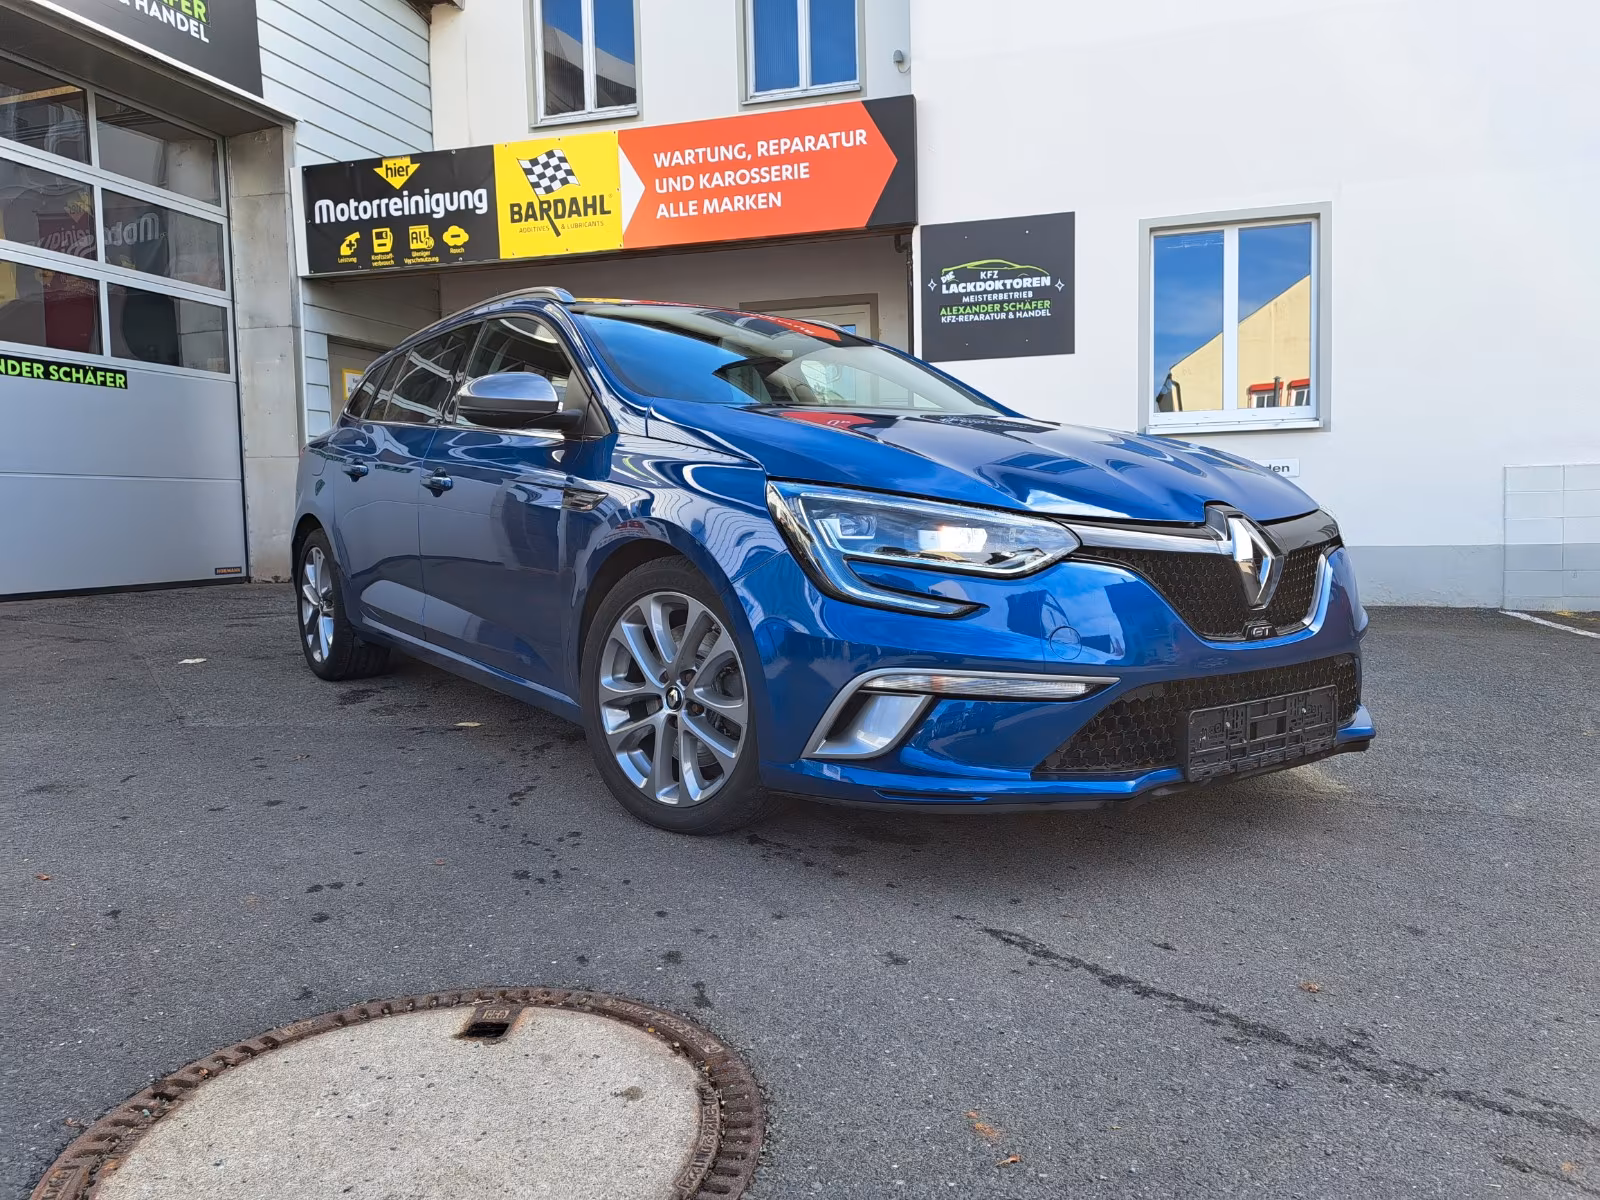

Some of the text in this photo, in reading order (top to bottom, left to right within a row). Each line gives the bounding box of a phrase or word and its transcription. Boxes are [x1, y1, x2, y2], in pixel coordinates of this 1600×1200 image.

[135, 0, 209, 43] HANDEL
[161, 0, 206, 22] ER
[653, 129, 867, 168] WARTUNG, REPARATUR
[385, 164, 410, 179] hier
[655, 162, 810, 193] UND KAROSSERIE
[314, 188, 488, 224] Motorreinigung
[509, 194, 612, 225] BARDAHL
[656, 192, 782, 219] ALLE MARKEN
[519, 225, 550, 234] ADDITIVES
[567, 220, 604, 230] LUBRICANTS
[942, 276, 1051, 294] LACKDOKTOREN
[980, 270, 999, 279] KFZ
[940, 300, 1051, 316] ALEXANDER SCHÄFER
[962, 291, 1033, 303] MEISTERBETRIEB
[941, 312, 1006, 323] KFZ-REPARATUR
[1016, 309, 1051, 318] HANDEL
[48, 365, 126, 388] SCHÄFER
